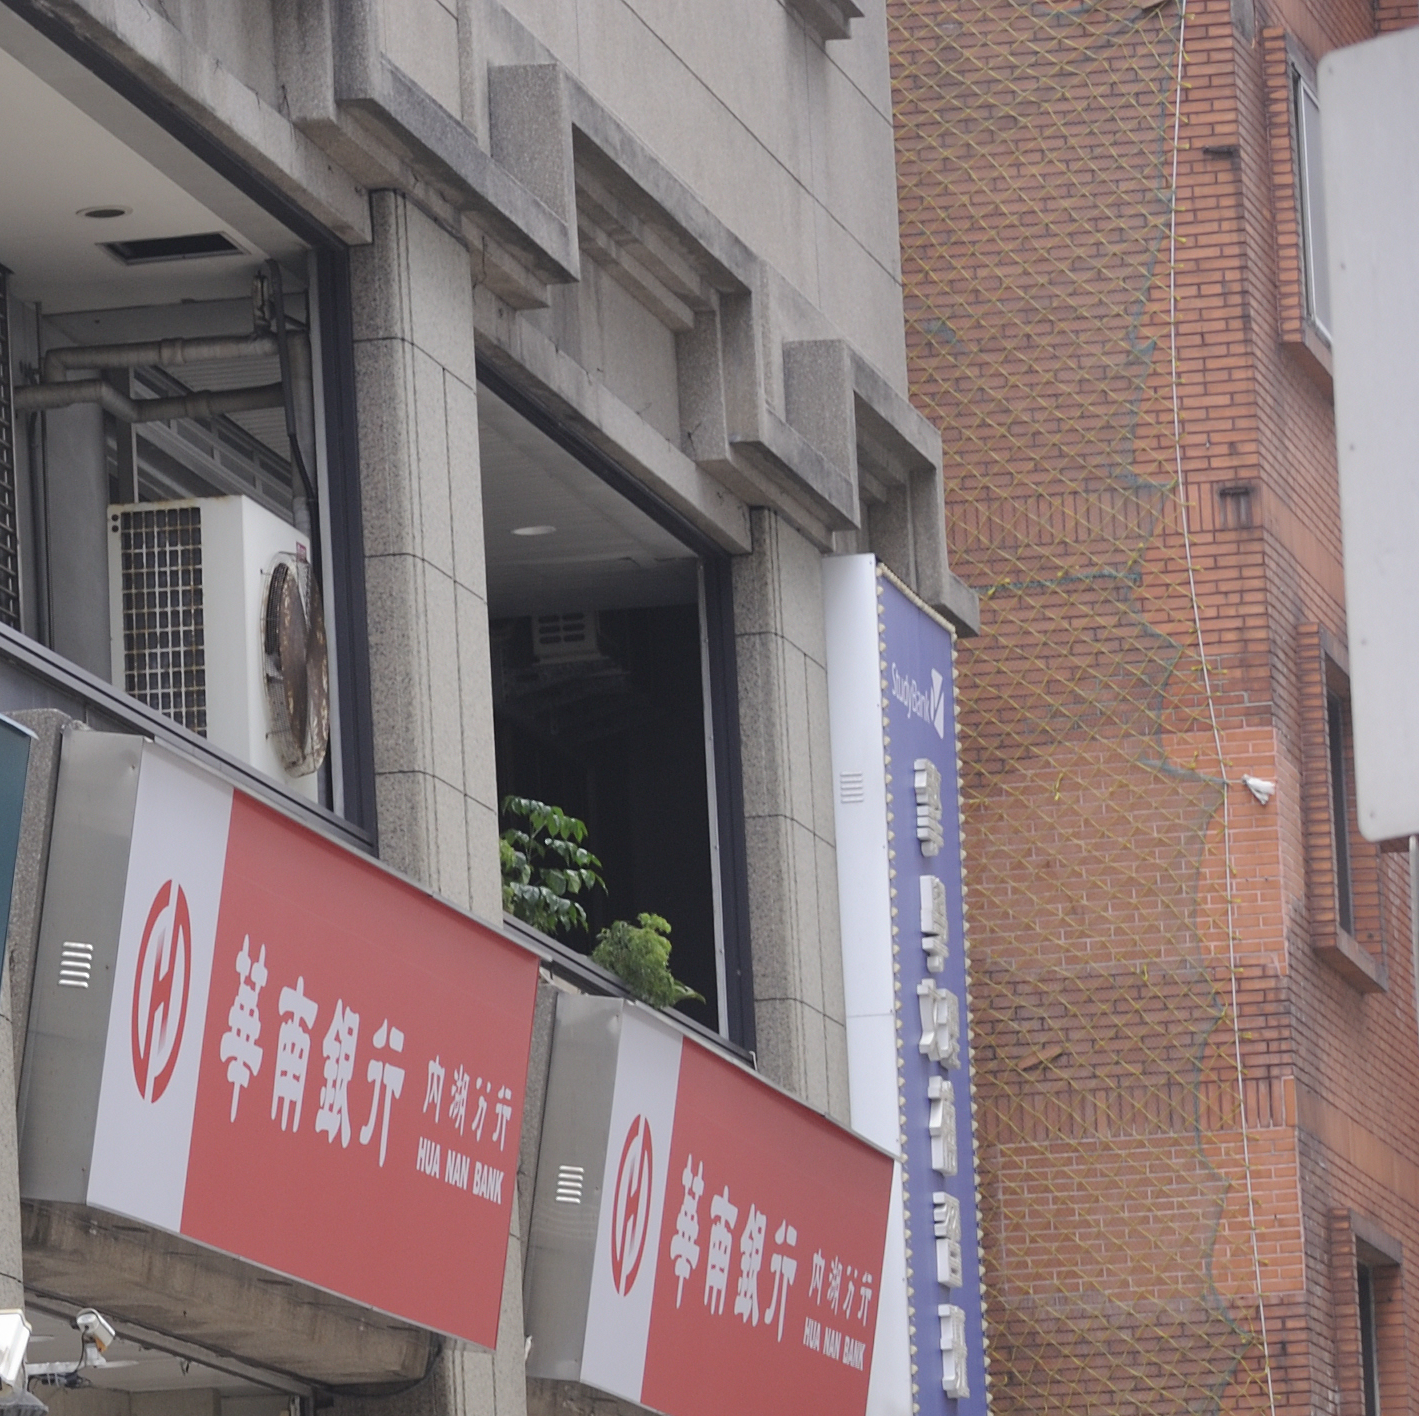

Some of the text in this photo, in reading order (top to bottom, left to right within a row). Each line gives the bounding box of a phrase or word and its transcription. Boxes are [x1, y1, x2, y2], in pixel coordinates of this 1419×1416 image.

[891, 661, 931, 724] StudyBank
[220, 934, 513, 1168] 華南銀行 內湖分行
[416, 1136, 505, 1206] HUA NAN BANK
[670, 1153, 873, 1343] 華南銀行 內湖分行
[802, 1317, 866, 1372] HUA NAN BANK
